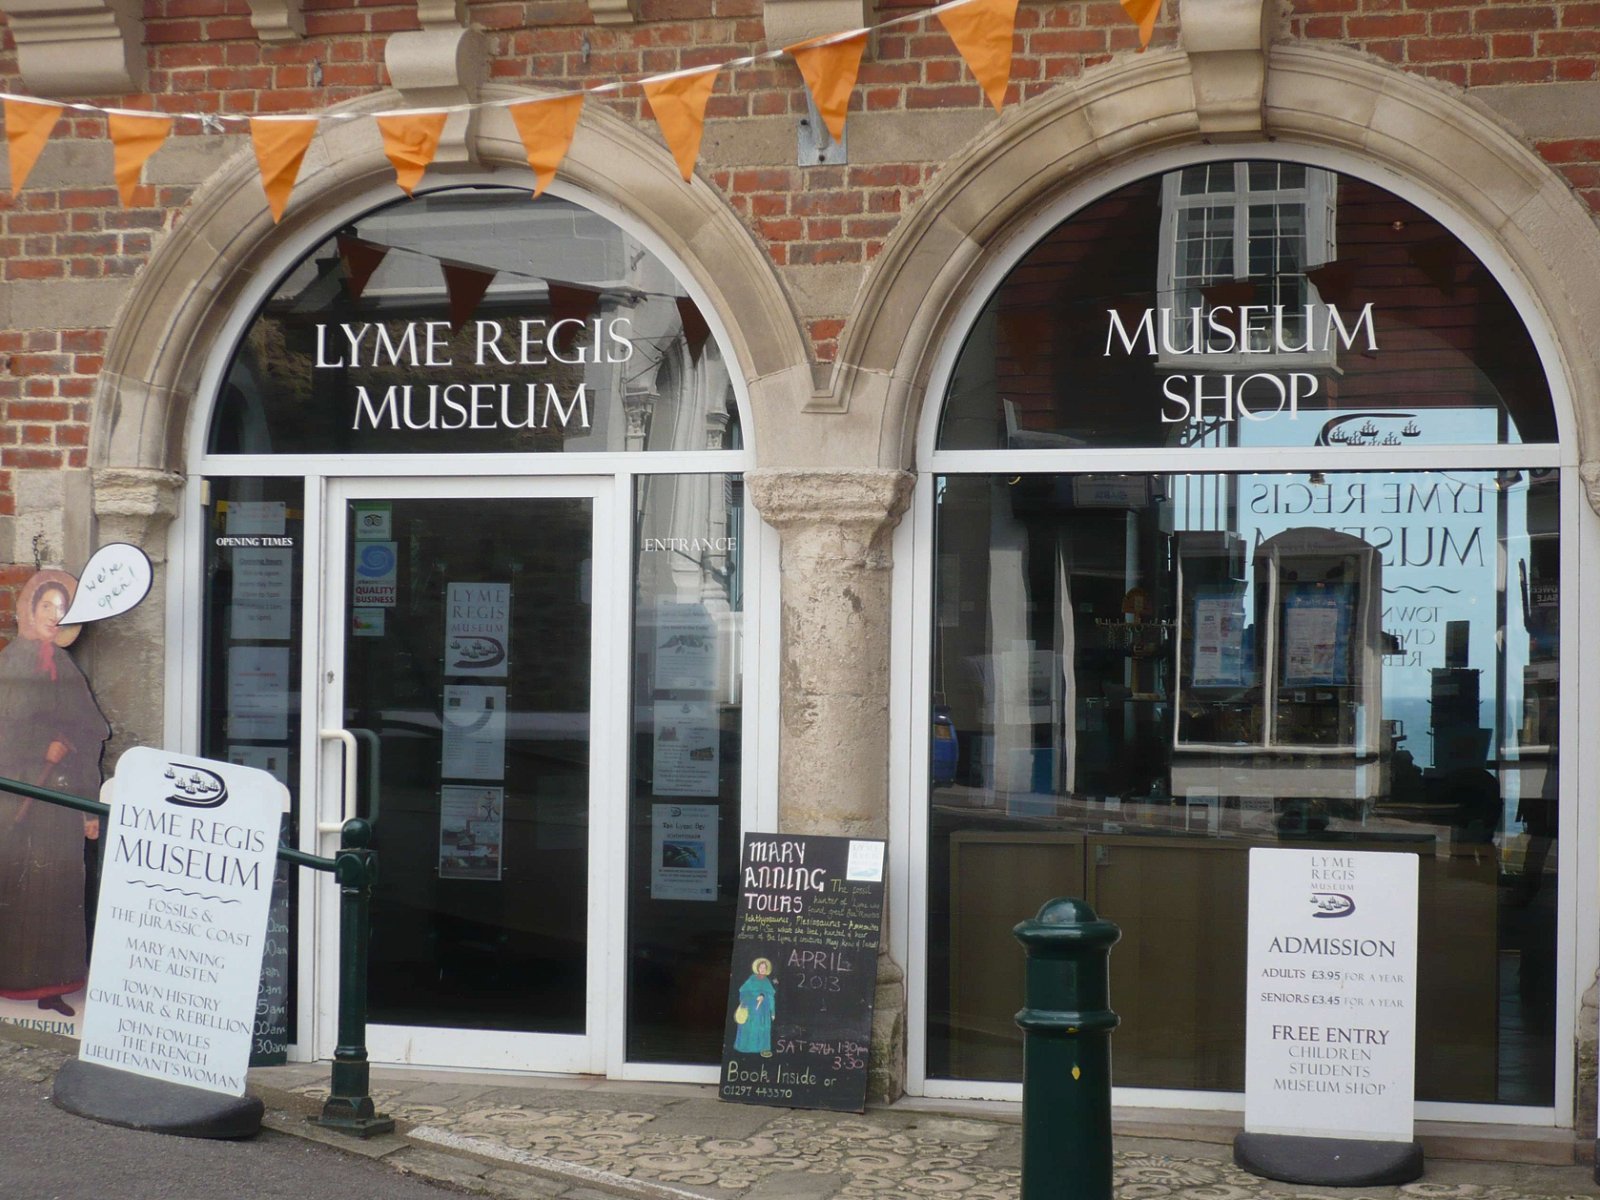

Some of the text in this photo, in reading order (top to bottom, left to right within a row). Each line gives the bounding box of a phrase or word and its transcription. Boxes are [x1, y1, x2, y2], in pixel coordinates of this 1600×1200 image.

[1103, 302, 1379, 357] MUSEUM
[315, 318, 633, 368] LYME REGIS
[352, 383, 591, 430] MUSEUM
[1161, 373, 1319, 423] SHOP
[216, 537, 294, 547] OPENING TIMES
[644, 537, 737, 552] ENTRANCE
[355, 586, 395, 595] QUALITY
[355, 595, 394, 604] BUSINESS
[453, 590, 505, 603] LYME
[452, 605, 505, 619] REGIS
[451, 624, 504, 633] MUSEUM
[120, 804, 183, 837] LYME
[190, 818, 265, 853] REGIS
[115, 834, 261, 891] MUSEUM
[749, 841, 806, 864] MARY
[1311, 856, 1355, 868] LYME
[744, 866, 827, 893] ANNING
[1311, 869, 1355, 881] REGIS
[1311, 883, 1355, 891] MUSEUM
[148, 898, 213, 923] FOSSILS &
[744, 893, 803, 913] TOURS
[111, 906, 253, 947] THE JURASSIC COAST
[126, 937, 225, 969] MARY ANNING
[1267, 936, 1396, 958] ADMISSION
[129, 954, 220, 984] JANE AUSTEN
[787, 949, 852, 971] APRIL
[796, 973, 841, 992] 2013
[1261, 968, 1405, 984] ADULTS £3.95 FOR A YEAR
[123, 979, 222, 1012] TOWN HISTORY
[1261, 992, 1405, 1008] SENIORS £3.45 FOR A YEAR
[89, 988, 252, 1035] CIVIL WAR & REBELLION
[117, 1018, 211, 1050] JOHN FOWLES
[1272, 1025, 1390, 1046] FREE ENTRY
[122, 1035, 208, 1066] THE FRENCH
[776, 1040, 807, 1054] SAT
[1288, 1046, 1372, 1061] CHILDREN
[85, 1043, 240, 1089] LIEUTENANT'S WOMAN
[727, 1060, 837, 1088] Book Inside or
[1289, 1063, 1371, 1078] STUDENTS
[723, 1086, 751, 1097] 01297
[1274, 1078, 1387, 1096] MUSEUM SHOP
